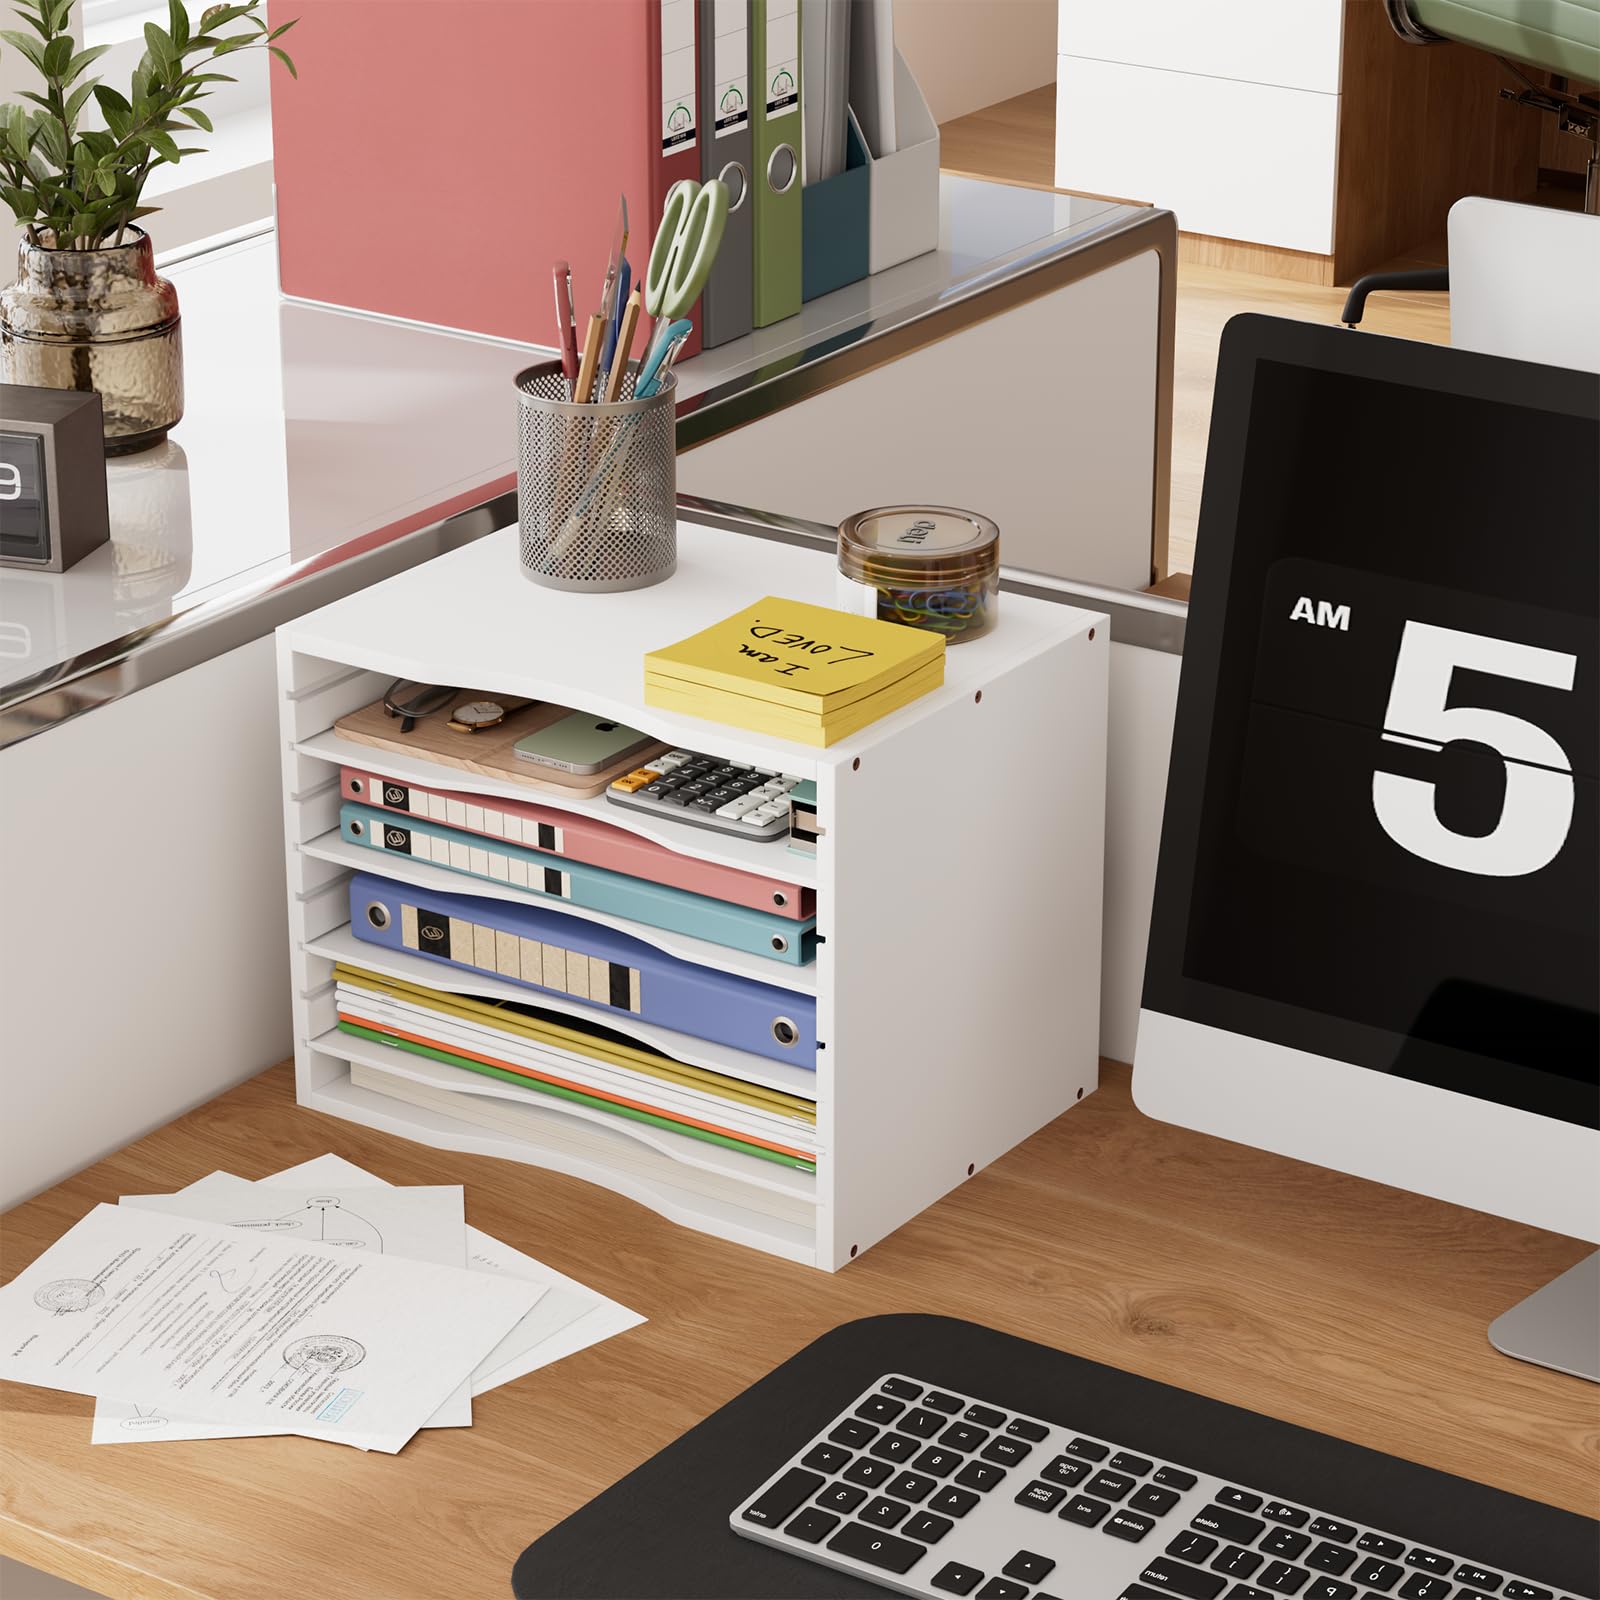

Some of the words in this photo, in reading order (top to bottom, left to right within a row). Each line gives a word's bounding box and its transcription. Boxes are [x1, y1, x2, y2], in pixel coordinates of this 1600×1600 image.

[1289, 596, 1351, 632] AM
[738, 643, 779, 663] am
[750, 619, 875, 664] LOVED.
[774, 663, 810, 677] I
[1372, 619, 1577, 877] 5
